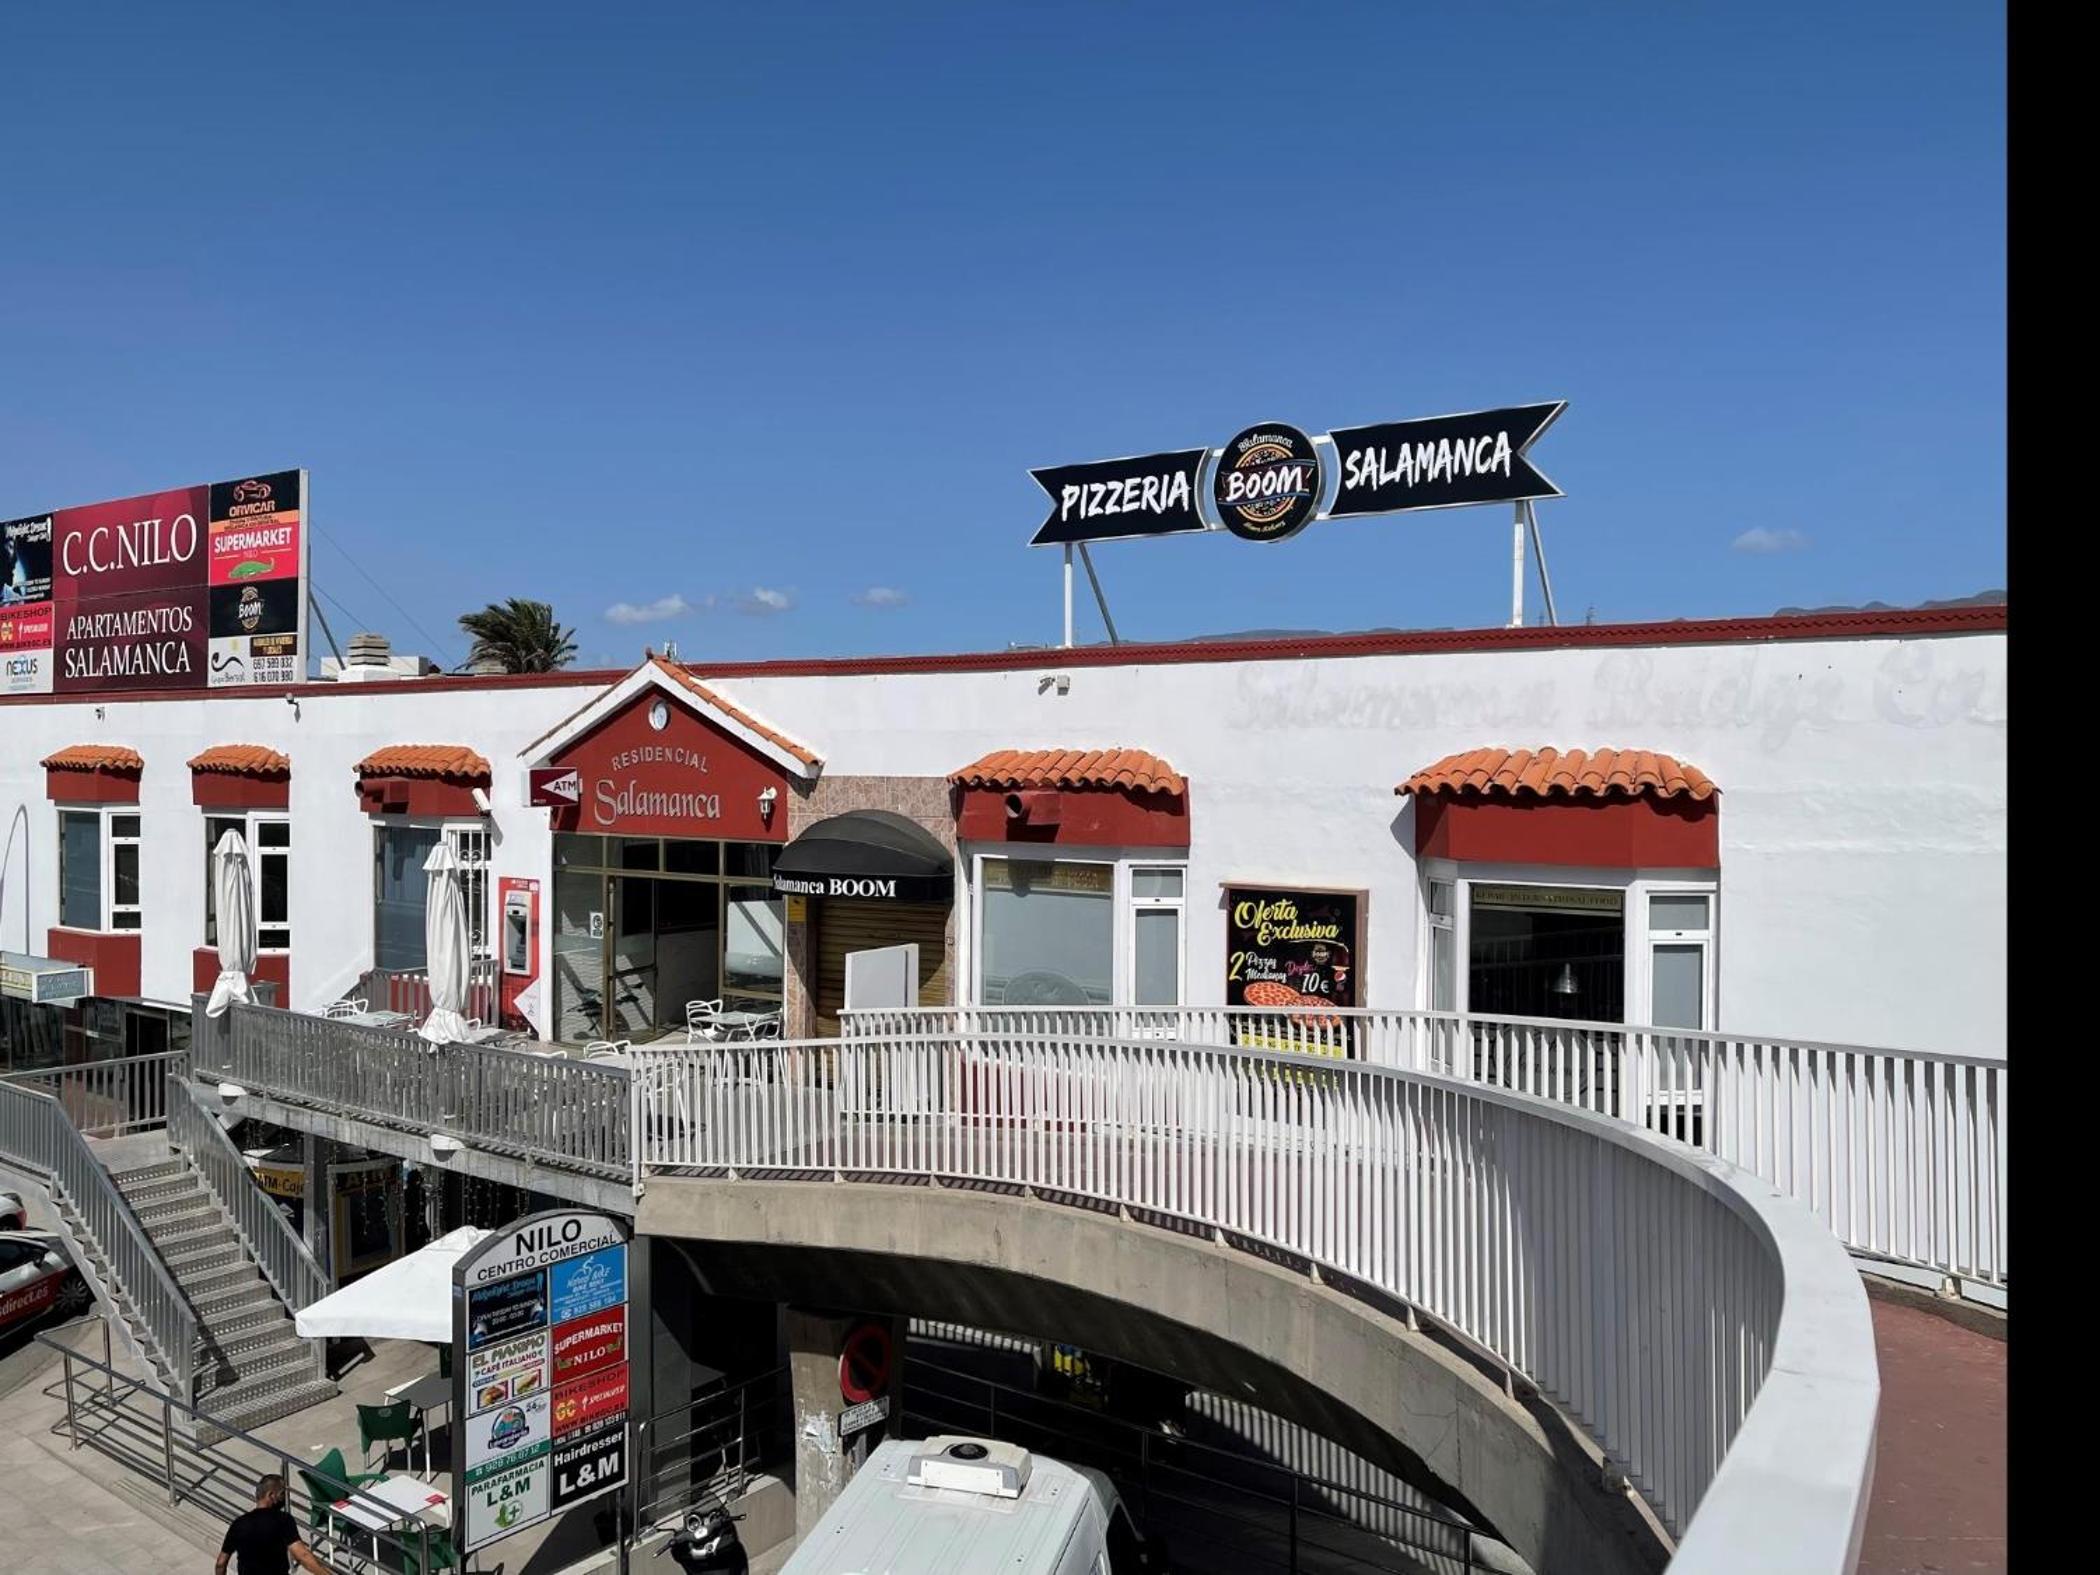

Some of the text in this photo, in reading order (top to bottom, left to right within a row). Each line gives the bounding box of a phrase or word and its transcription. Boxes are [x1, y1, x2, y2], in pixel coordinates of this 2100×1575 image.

[1344, 431, 1513, 490] SALAMANCA
[1061, 470, 1191, 522] PIZZERIA
[1226, 466, 1304, 502] BOOM
[62, 513, 198, 576] C.C.NILO
[214, 527, 292, 554] SUPERMARKET
[67, 605, 193, 640] APARTAMENTOS
[65, 641, 191, 679] SALAMANCA
[612, 746, 708, 774] RESIDENCIAL
[553, 780, 577, 792] ATM
[594, 779, 721, 826] Salamanca
[829, 877, 897, 898] BOOM
[1234, 898, 1298, 929] Oferta
[1256, 921, 1339, 946] Exclusiva
[1228, 951, 1246, 981] 2
[1245, 951, 1277, 970] Pizzas
[516, 1218, 582, 1257] NILO
[477, 1256, 536, 1281] CENTRO
[539, 1234, 617, 1264] COMERCIAL
[554, 1322, 624, 1355] SUPERMARKET
[472, 1353, 489, 1369] EL
[502, 1351, 537, 1369] ITALIANO
[573, 1346, 606, 1366] NILO
[554, 1430, 624, 1468] Hairdresser
[471, 1460, 544, 1497] PARAFARMACIA
[559, 1451, 619, 1497] L&M
[487, 1476, 531, 1508] L&M
